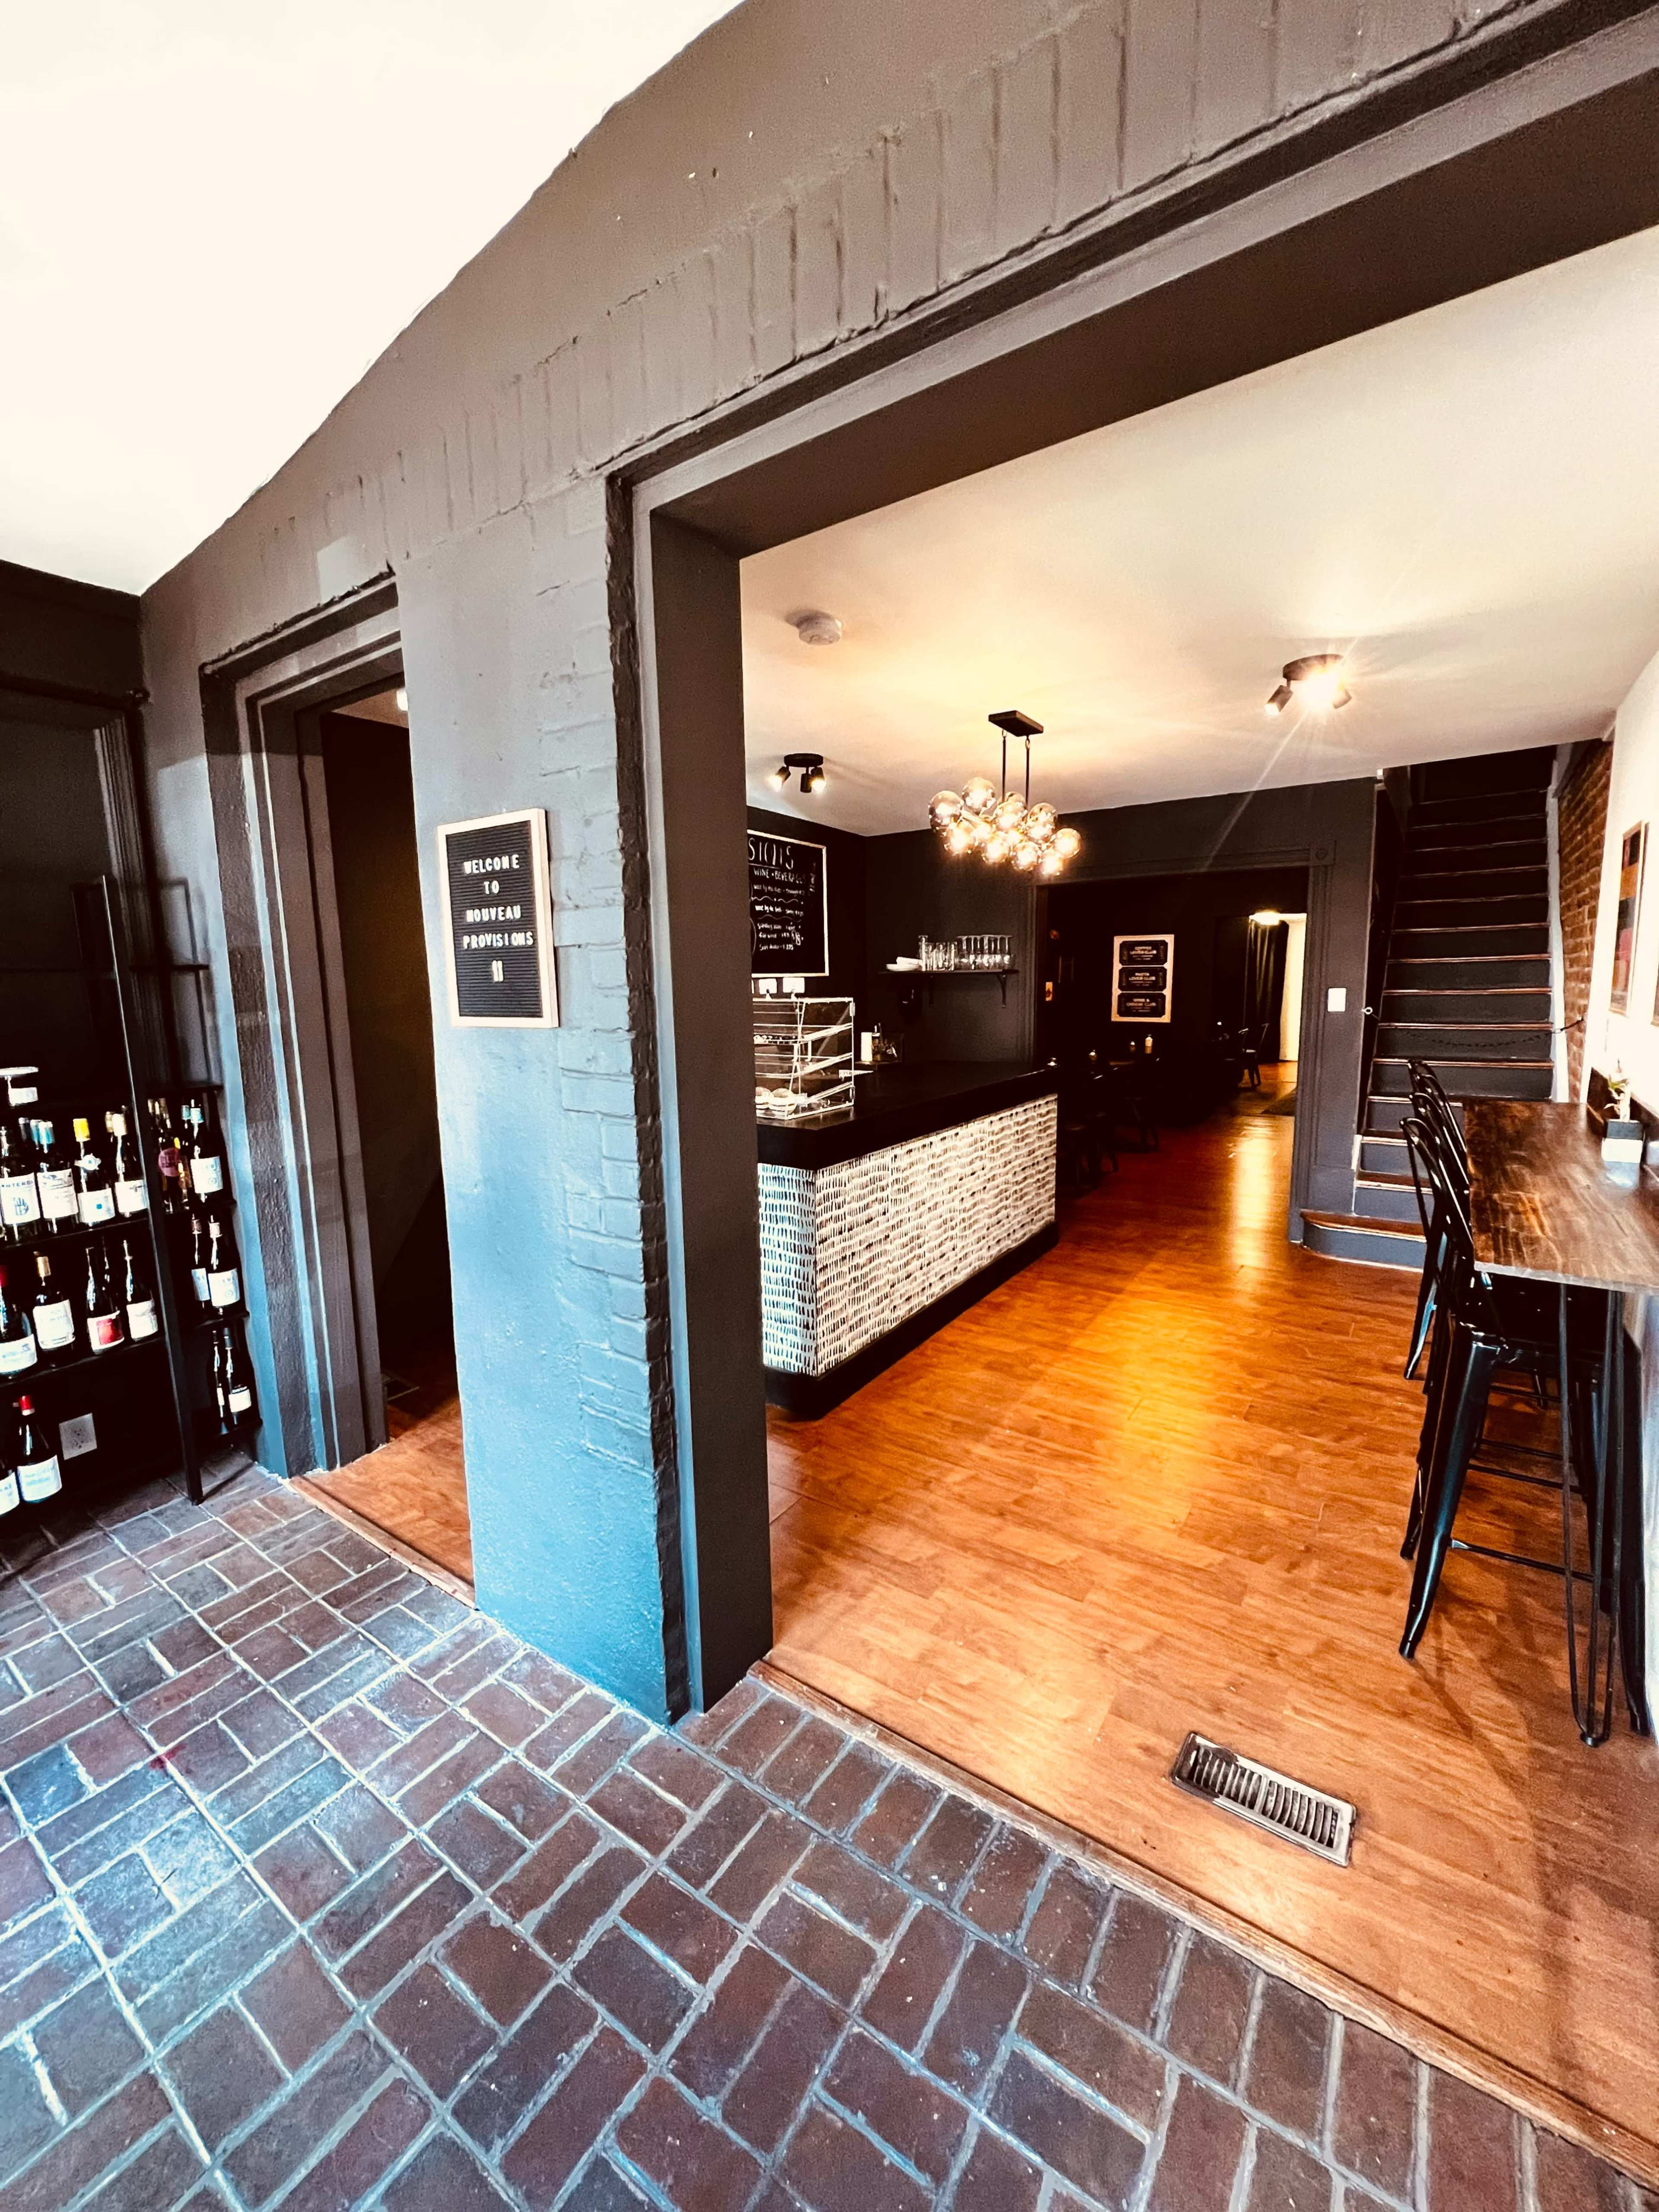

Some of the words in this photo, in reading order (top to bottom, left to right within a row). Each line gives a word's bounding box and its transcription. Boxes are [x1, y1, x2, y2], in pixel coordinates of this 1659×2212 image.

[463, 854, 520, 874] WELCOME
[753, 867, 769, 878] WINE
[483, 880, 500, 895] TO
[466, 905, 521, 923] NOUVEAU
[463, 931, 534, 949] PROVISIONS
